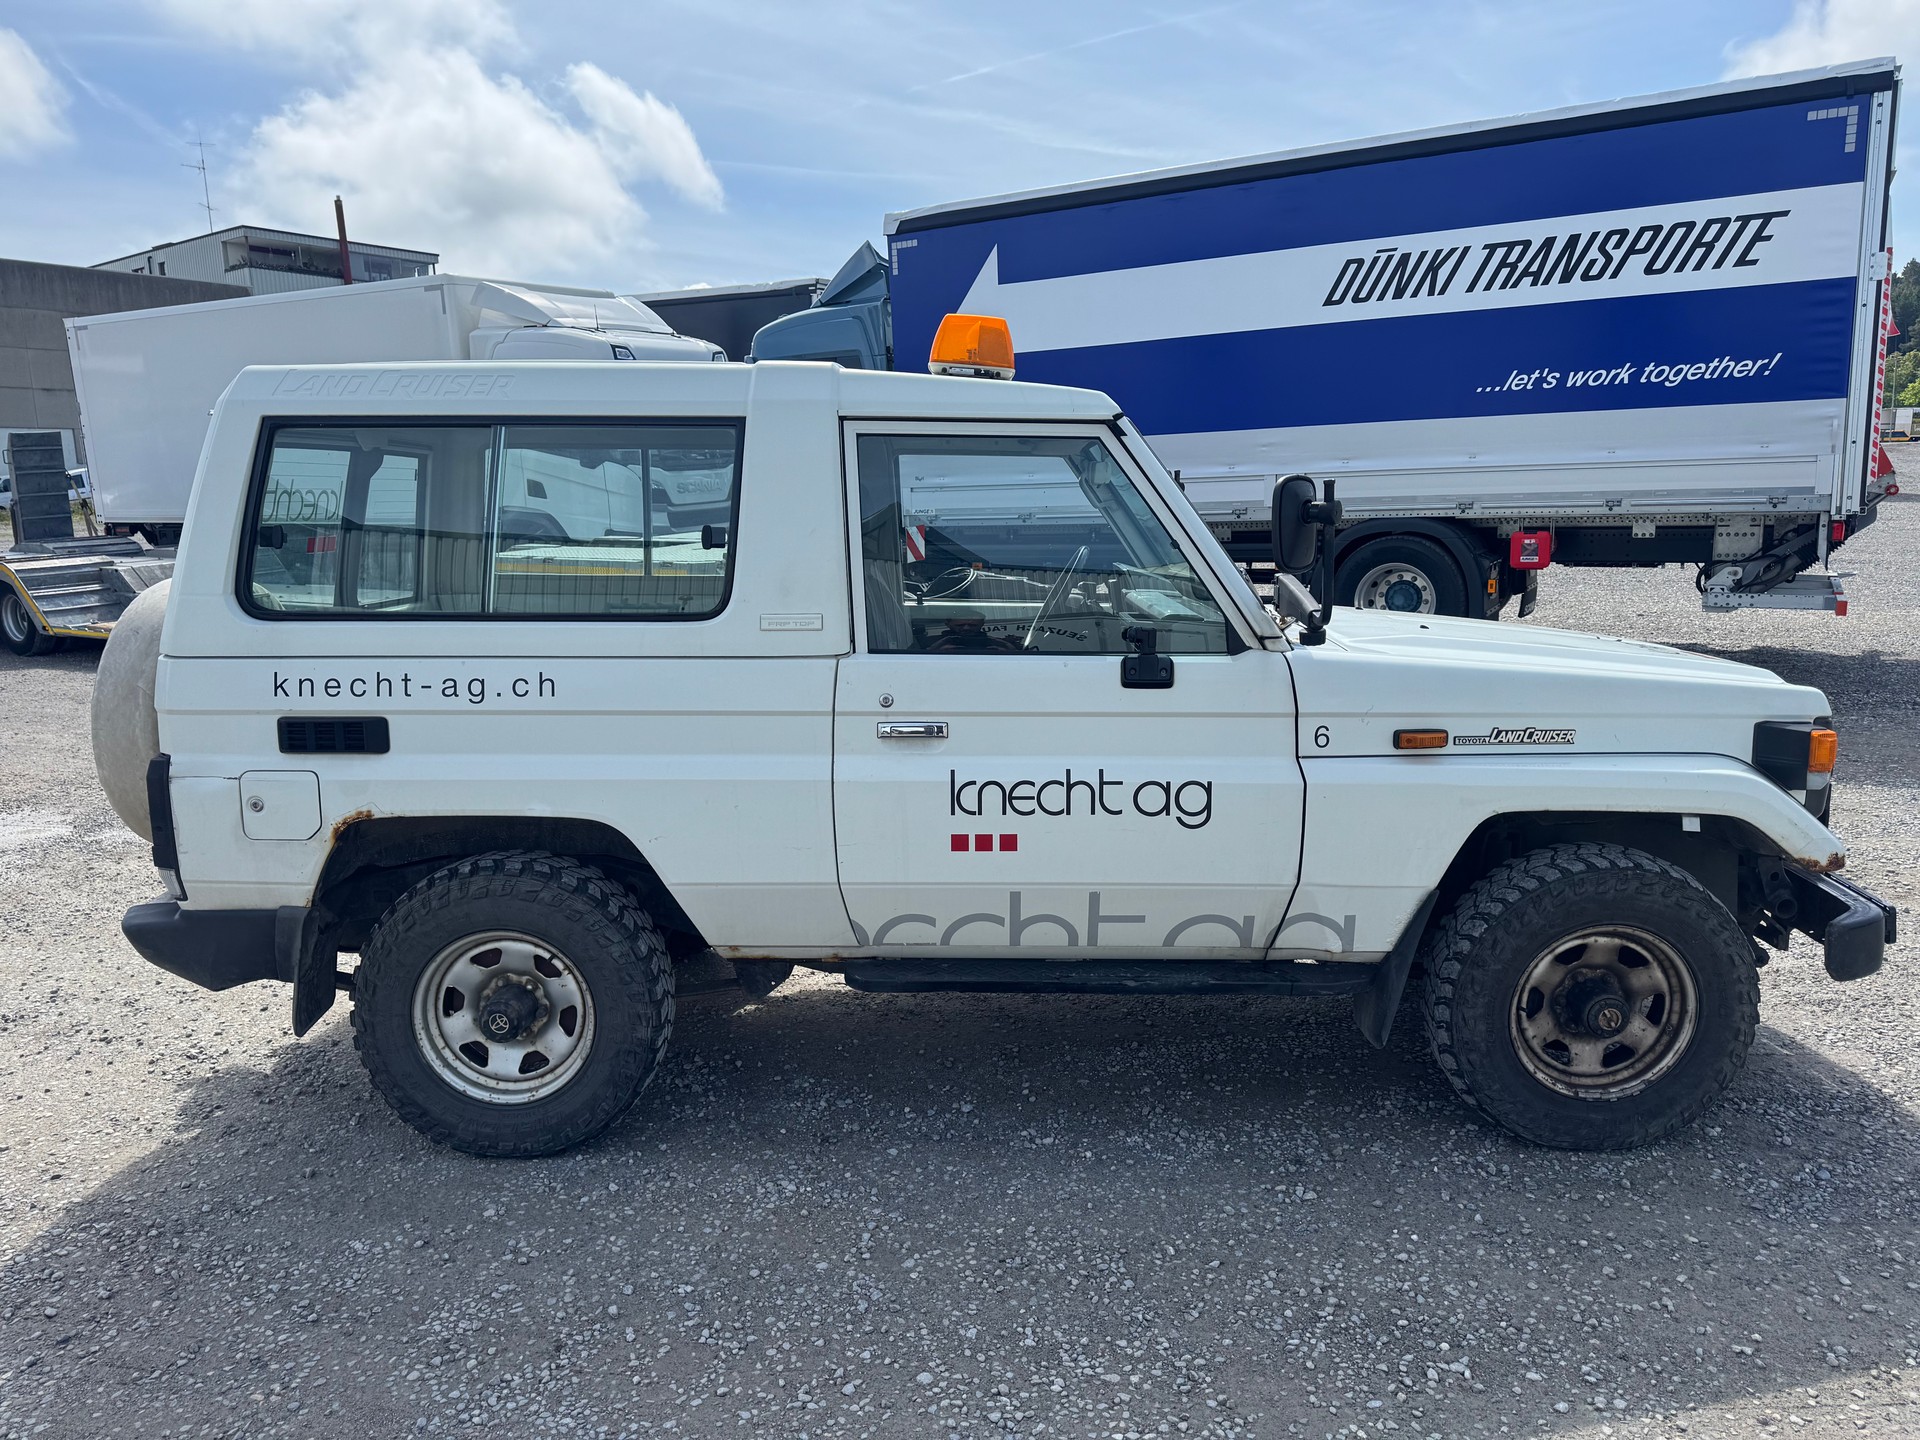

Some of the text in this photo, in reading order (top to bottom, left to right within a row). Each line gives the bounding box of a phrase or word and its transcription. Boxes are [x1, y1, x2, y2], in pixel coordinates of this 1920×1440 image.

[1465, 209, 1792, 294] TRANSPORTE
[1566, 360, 1637, 388] work
[1639, 352, 1783, 388] together!
[273, 671, 556, 704] knecht-ag.ch
[1314, 725, 1330, 748] 6
[950, 768, 1213, 830] knecht ag
